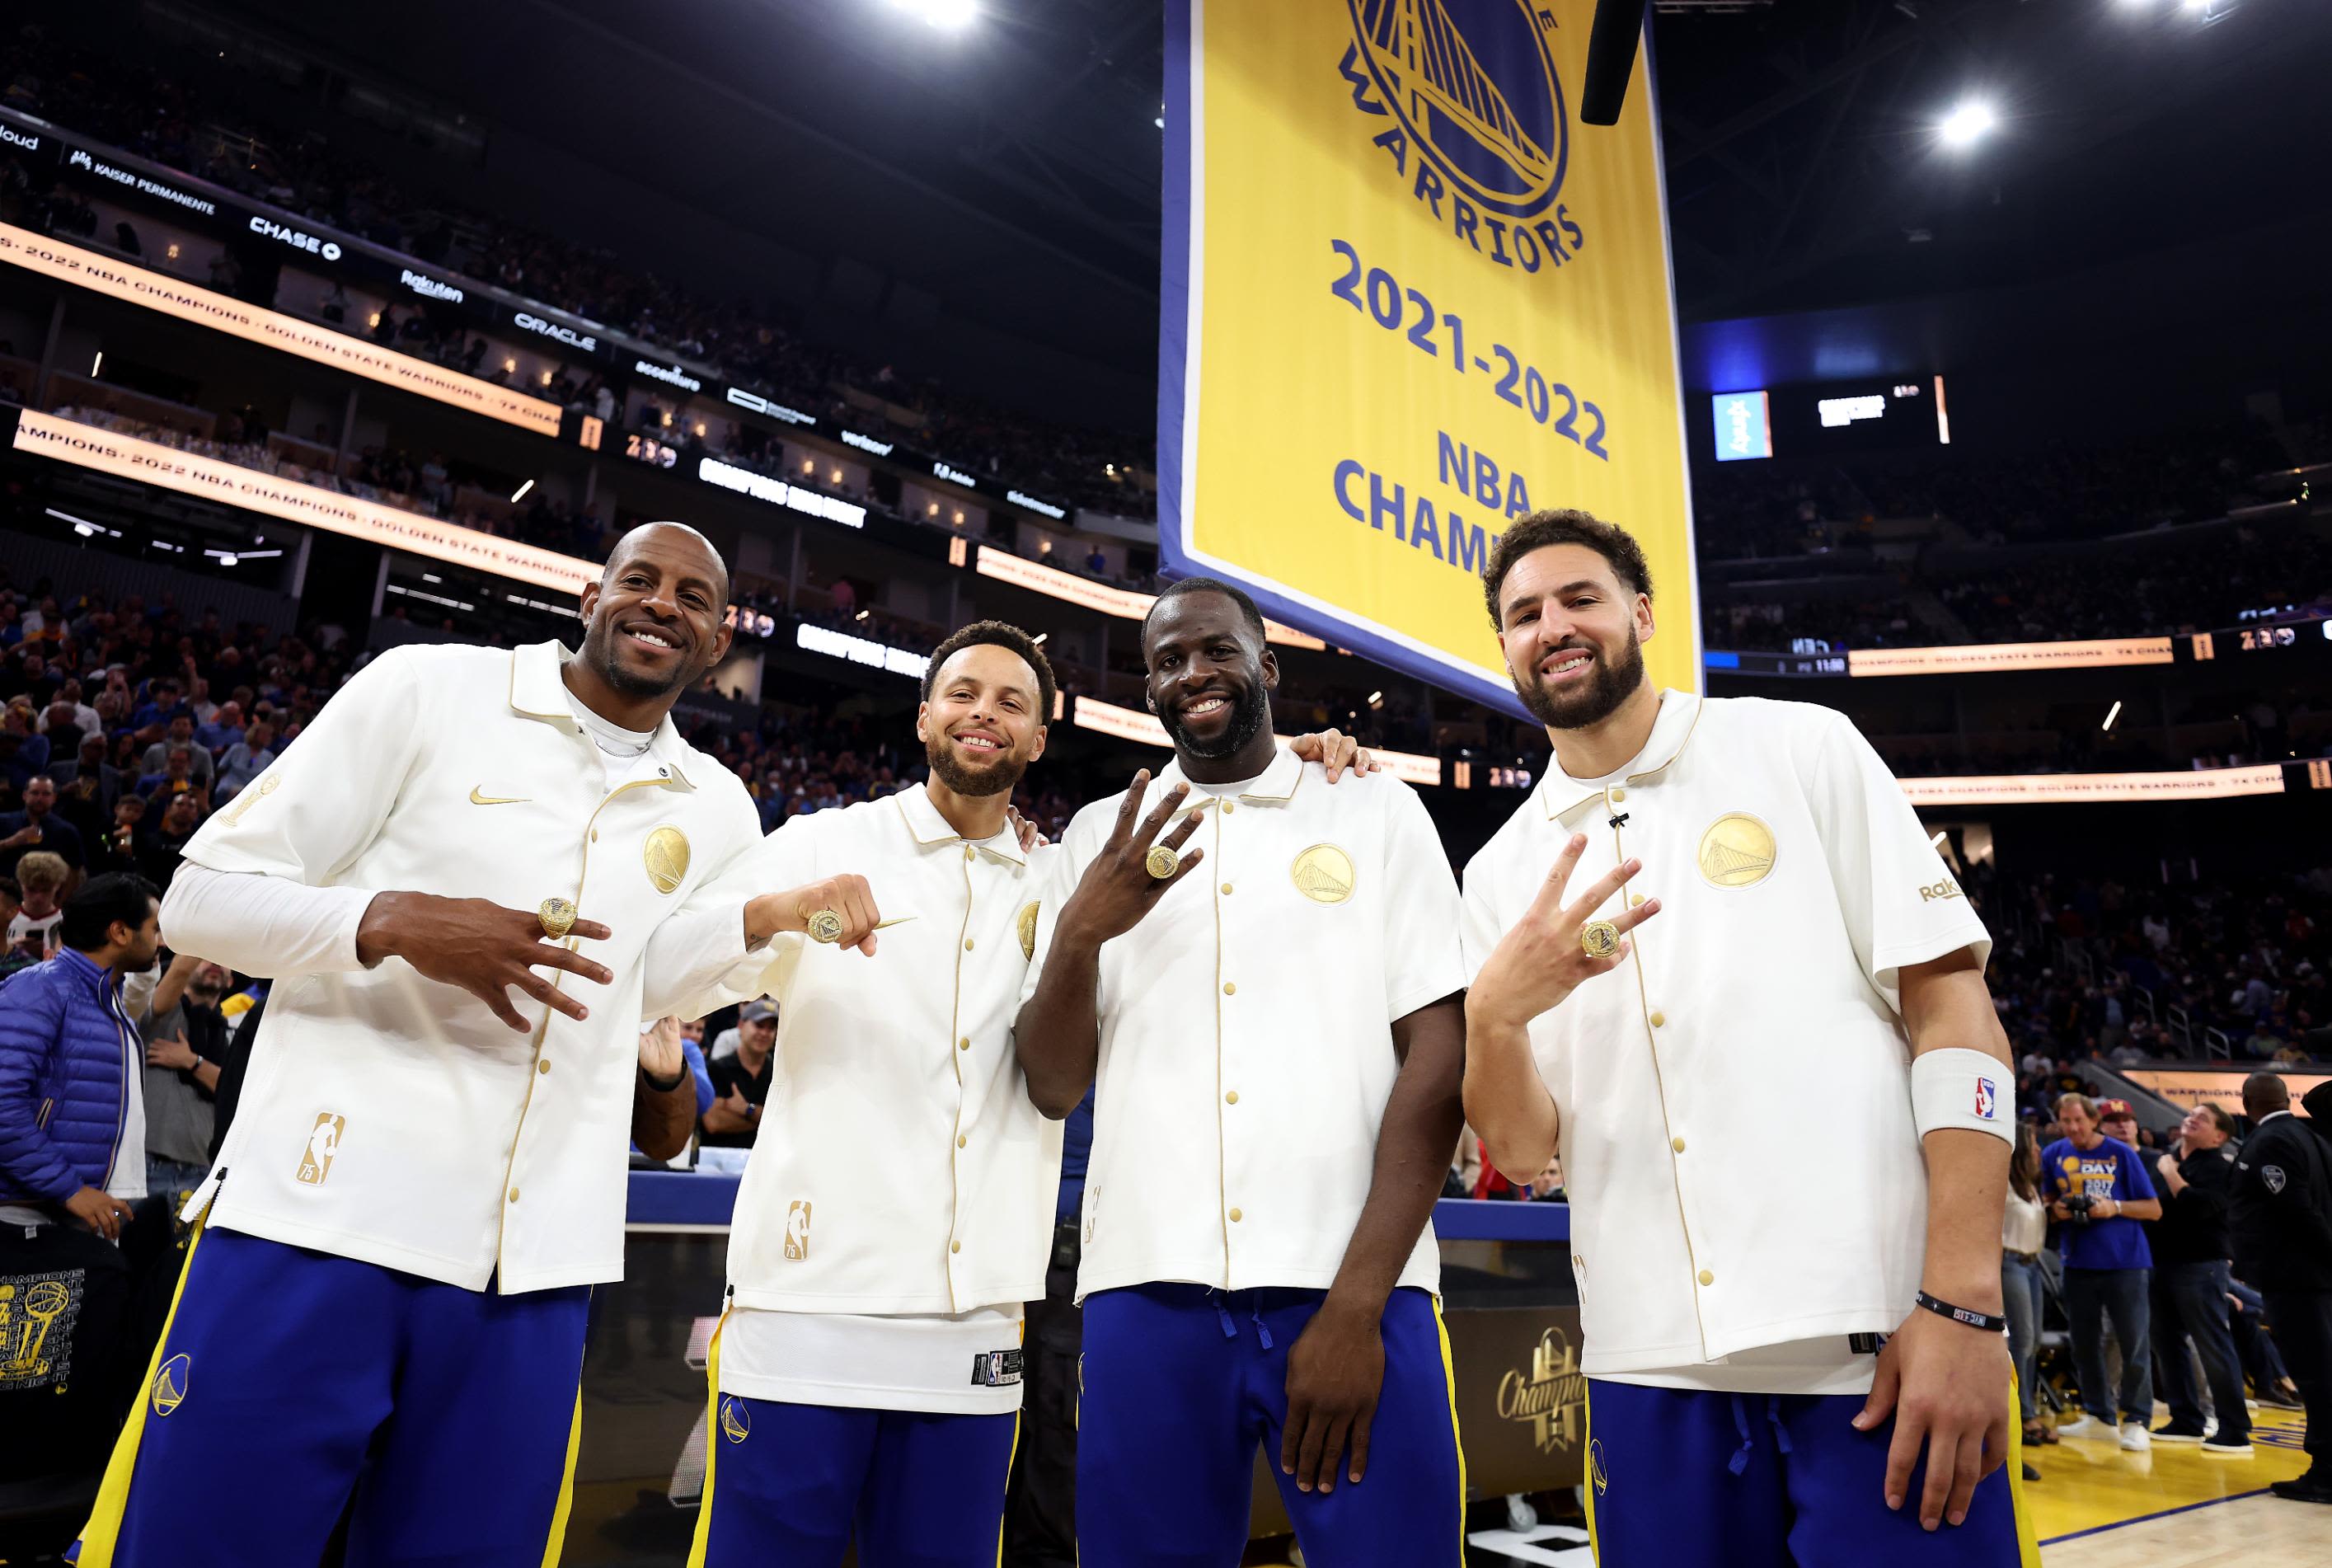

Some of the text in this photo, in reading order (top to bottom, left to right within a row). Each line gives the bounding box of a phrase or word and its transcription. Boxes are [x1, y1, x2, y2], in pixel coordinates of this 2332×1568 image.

[1338, 39, 1584, 273] WARRIORS
[93, 162, 216, 216] KAISER PERMANENTE
[250, 216, 320, 254] CHASE
[401, 269, 464, 303] Rakuten
[26, 246, 80, 271] 2022
[87, 266, 128, 285] NBA
[134, 281, 251, 325] CHAMPIONS
[265, 323, 336, 354] GOLDEN
[342, 349, 393, 371] STATE
[397, 366, 485, 401] WARRIORS
[514, 312, 597, 352] ORACLE
[1330, 239, 1608, 462] 2021-2022
[1437, 430, 1532, 520] NBA
[131, 453, 186, 475] 2022
[193, 471, 233, 488] NBA
[241, 483, 357, 521] CHAMPIONS
[372, 519, 444, 544] GOLDEN
[449, 539, 501, 558] STATE
[505, 552, 592, 582] WARRIORS
[1333, 459, 1499, 580] CHAM
[298, 1162, 316, 1181] 75
[2081, 1163, 2118, 1175] DAY
[786, 1244, 796, 1258] 75
